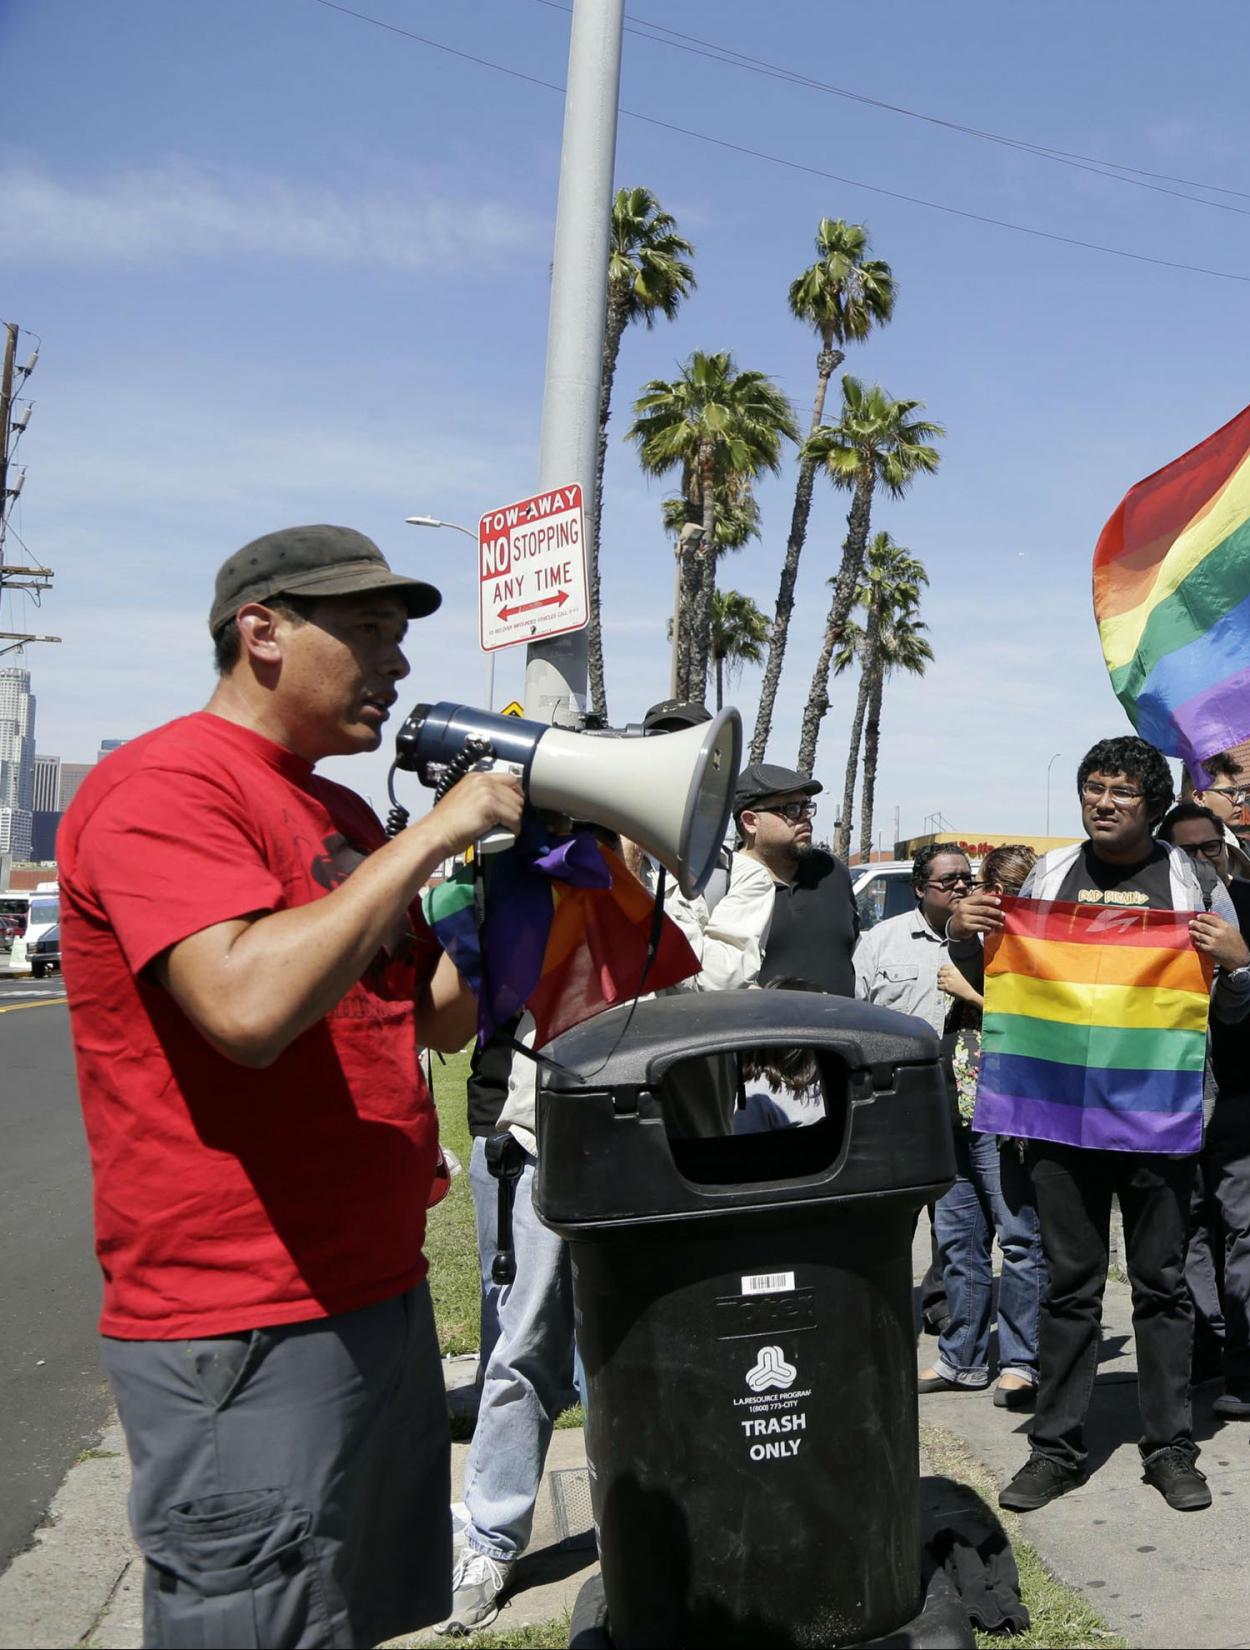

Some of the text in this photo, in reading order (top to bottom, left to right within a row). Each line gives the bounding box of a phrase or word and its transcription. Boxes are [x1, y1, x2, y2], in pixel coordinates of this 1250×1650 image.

[482, 487, 578, 534] TOW-AWAY
[482, 518, 579, 577] NO STOPPING
[493, 561, 573, 604] ANY TIME
[741, 1413, 806, 1437] TRASH
[750, 1438, 801, 1461] ONLY
